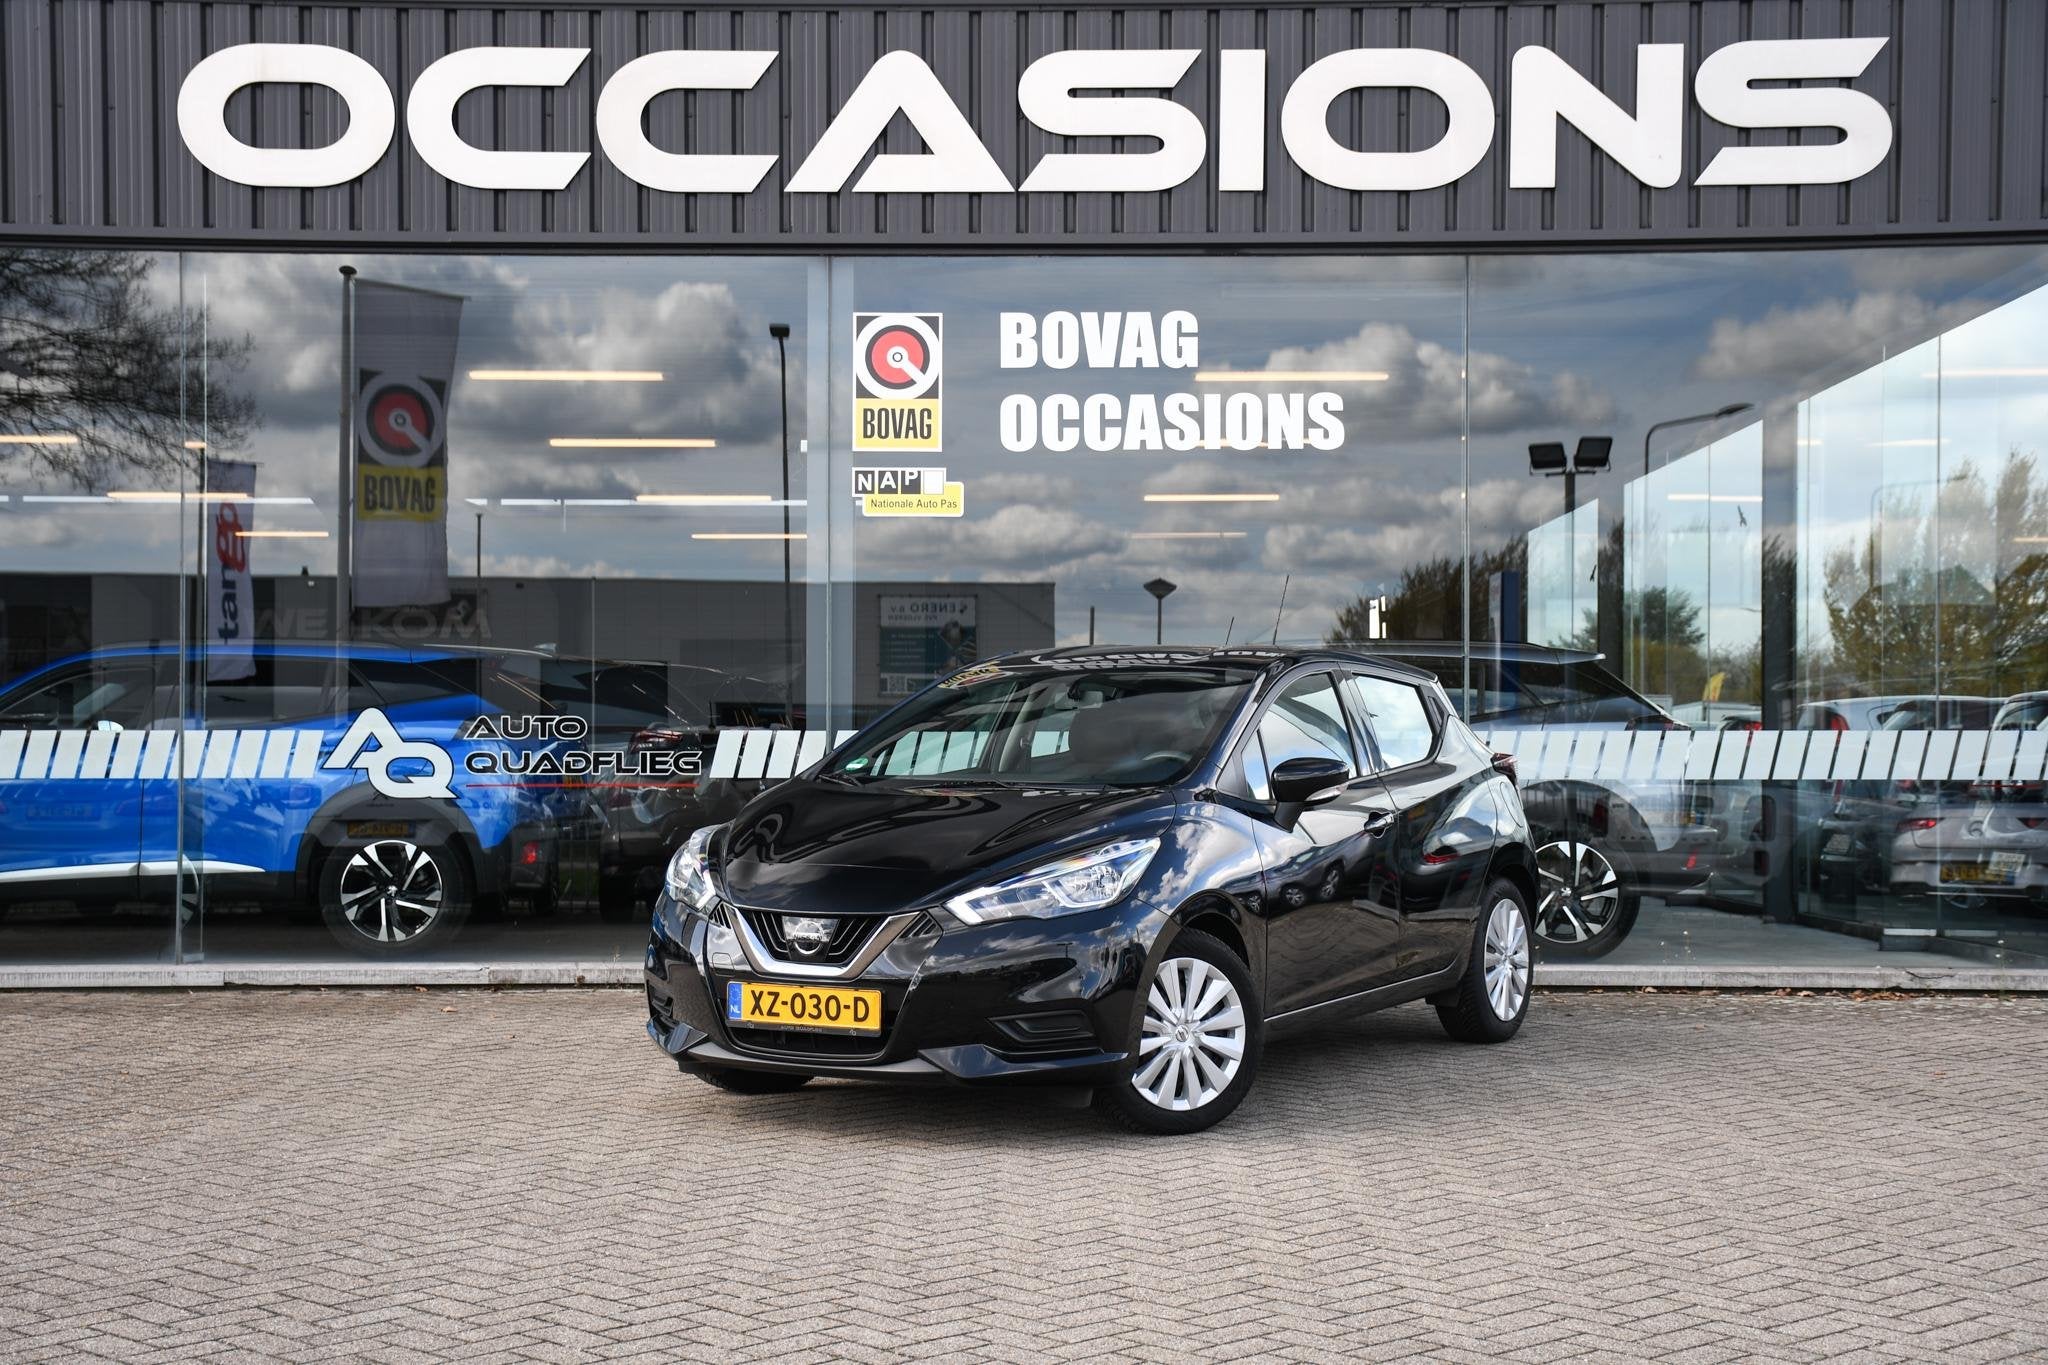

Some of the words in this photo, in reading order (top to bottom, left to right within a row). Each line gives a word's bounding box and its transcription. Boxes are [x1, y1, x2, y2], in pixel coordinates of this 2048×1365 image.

[177, 36, 1894, 193] OCCASIONS
[999, 309, 1199, 369] BOVAG
[862, 407, 933, 441] BOVAG
[999, 391, 1345, 453] OCCASIONS
[363, 473, 436, 512] BOVAG
[857, 468, 919, 491] NAP
[870, 498, 914, 509] Nationale
[916, 499, 938, 509] Auto
[940, 499, 958, 509] Pas
[463, 715, 588, 741] AUTO
[463, 750, 703, 776] QUADFLIEG
[730, 1004, 741, 1014] NL
[750, 989, 870, 1022] XZ-030-D
